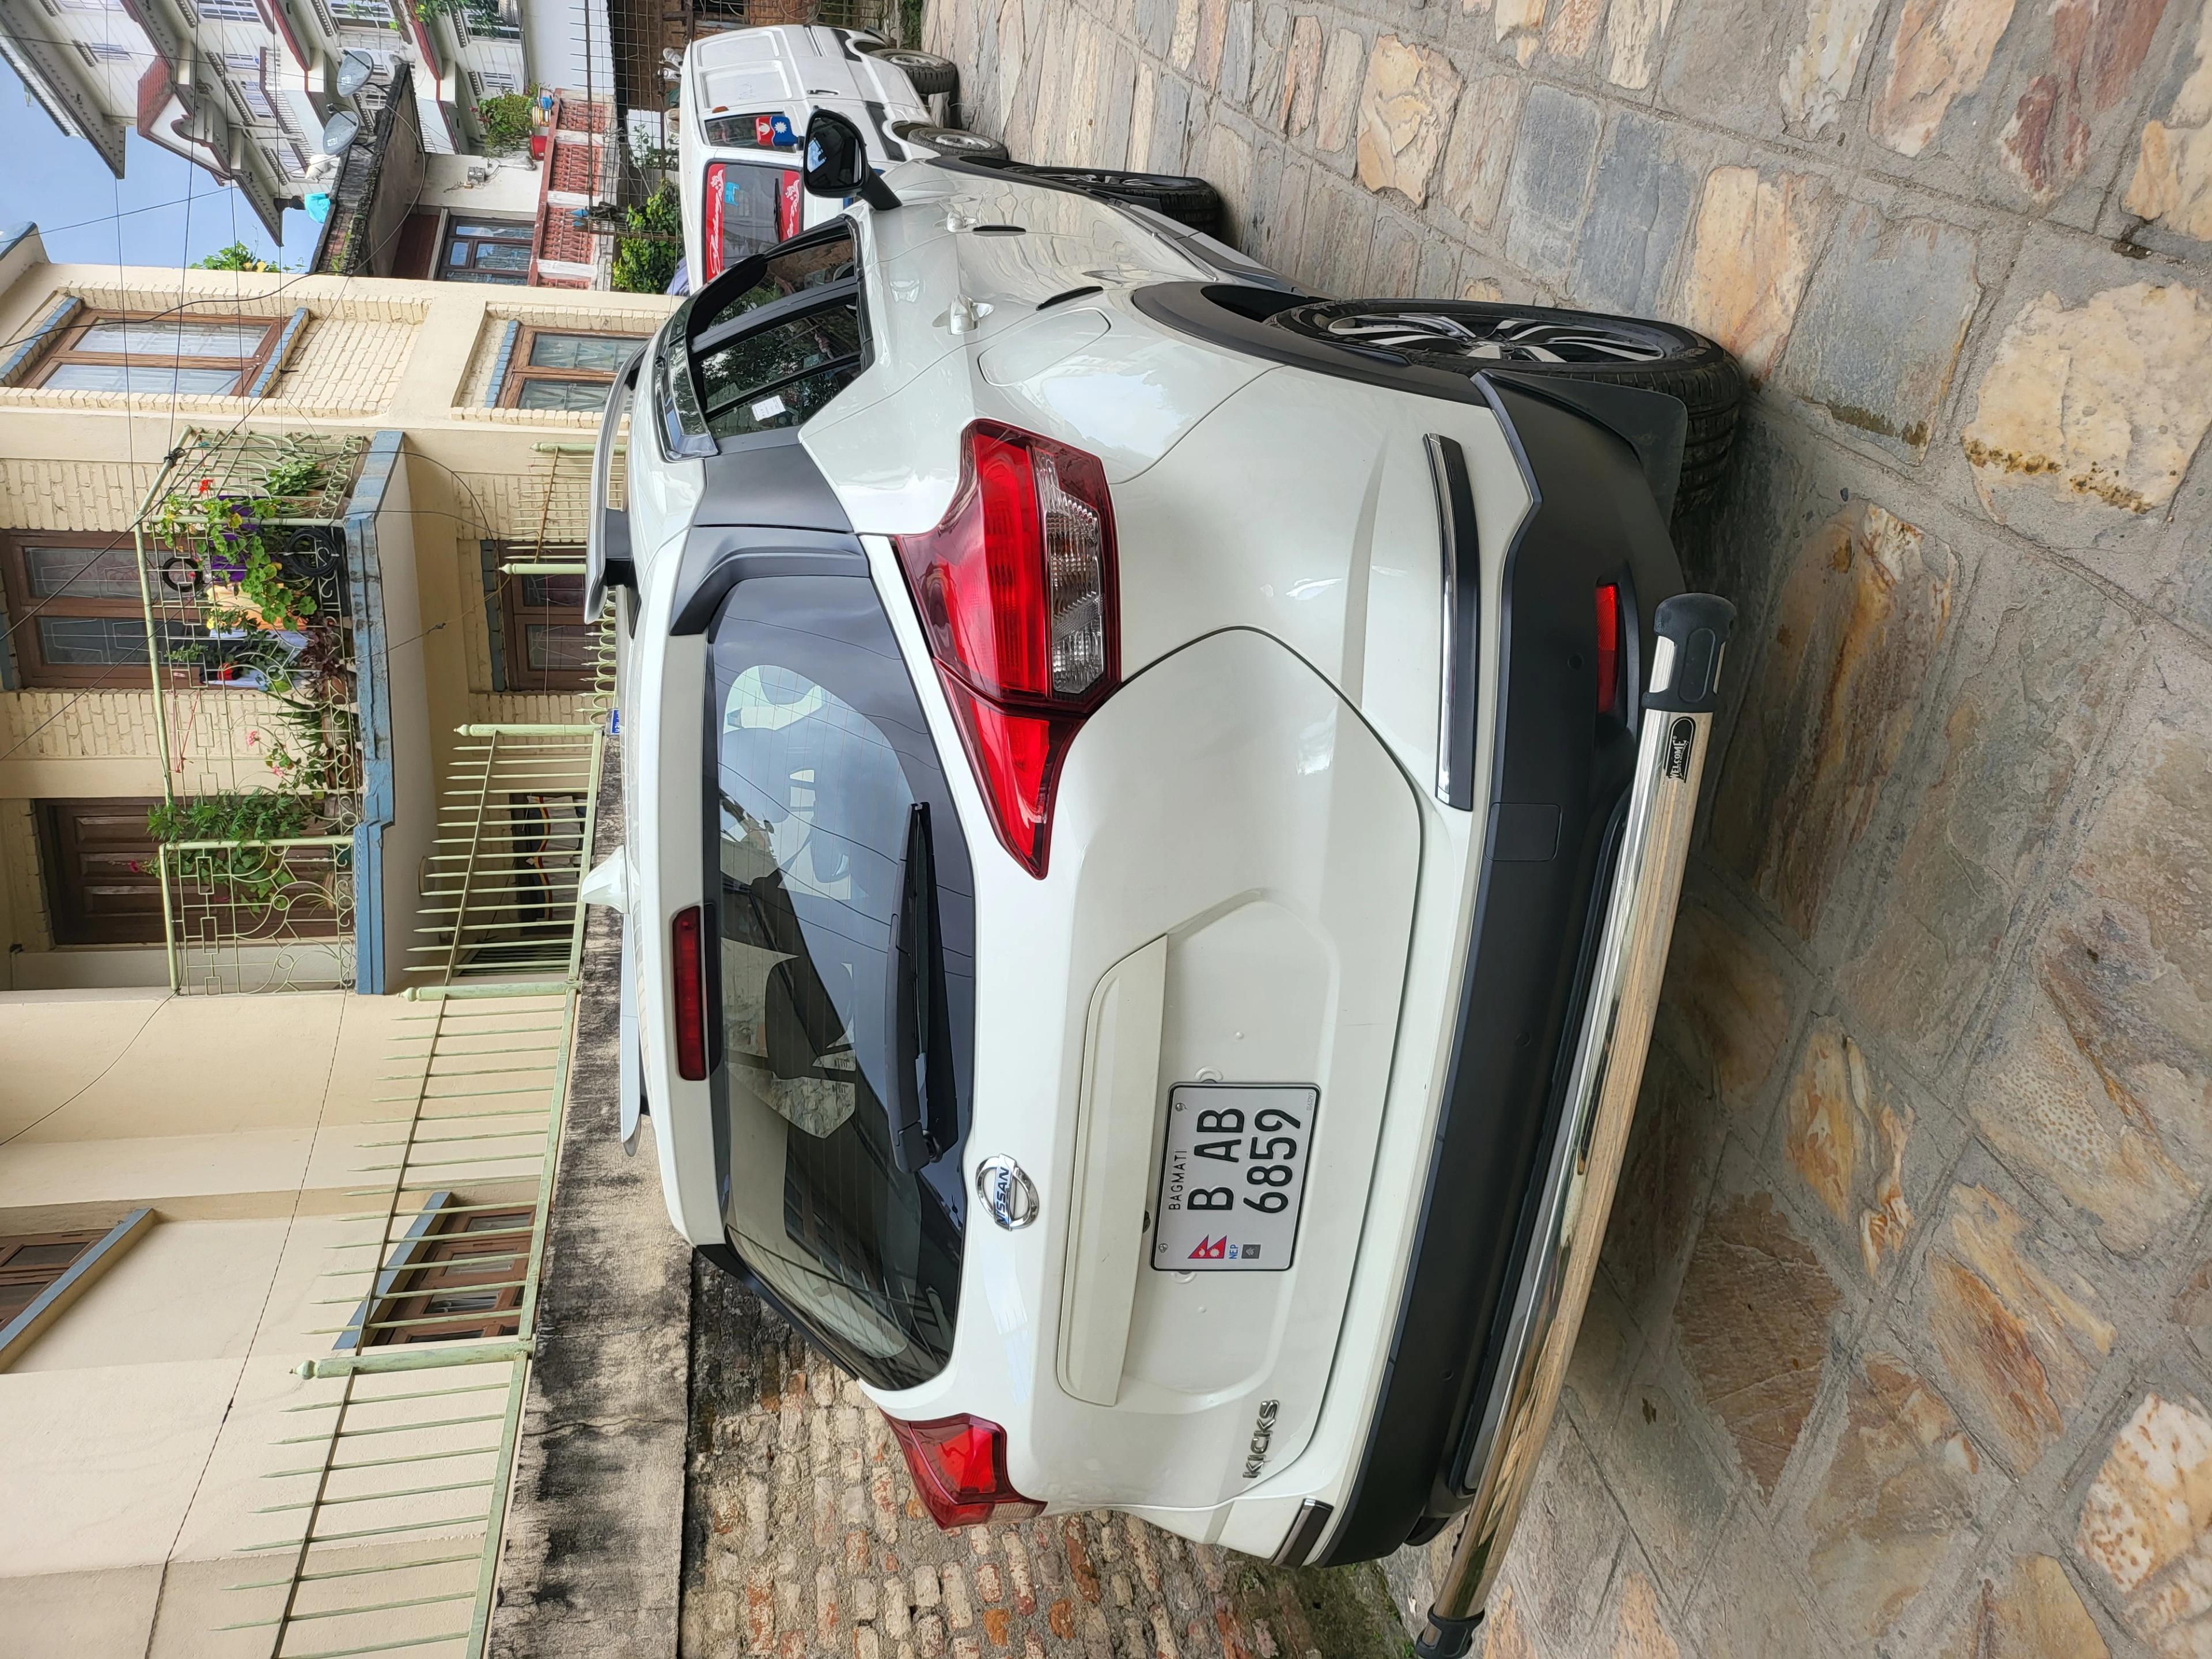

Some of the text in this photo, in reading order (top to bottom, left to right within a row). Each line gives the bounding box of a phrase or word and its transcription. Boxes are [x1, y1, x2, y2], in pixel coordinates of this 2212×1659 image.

[1669, 739, 1687, 780] WELCOME
[1168, 1150, 1187, 1210] BAGMATI
[1187, 1108, 1245, 1210] B AB
[1243, 1108, 1301, 1214] 6859
[996, 1166, 1009, 1225] NISSAN
[1229, 1244, 1238, 1259] NEP
[1242, 1399, 1279, 1479] KICKS
